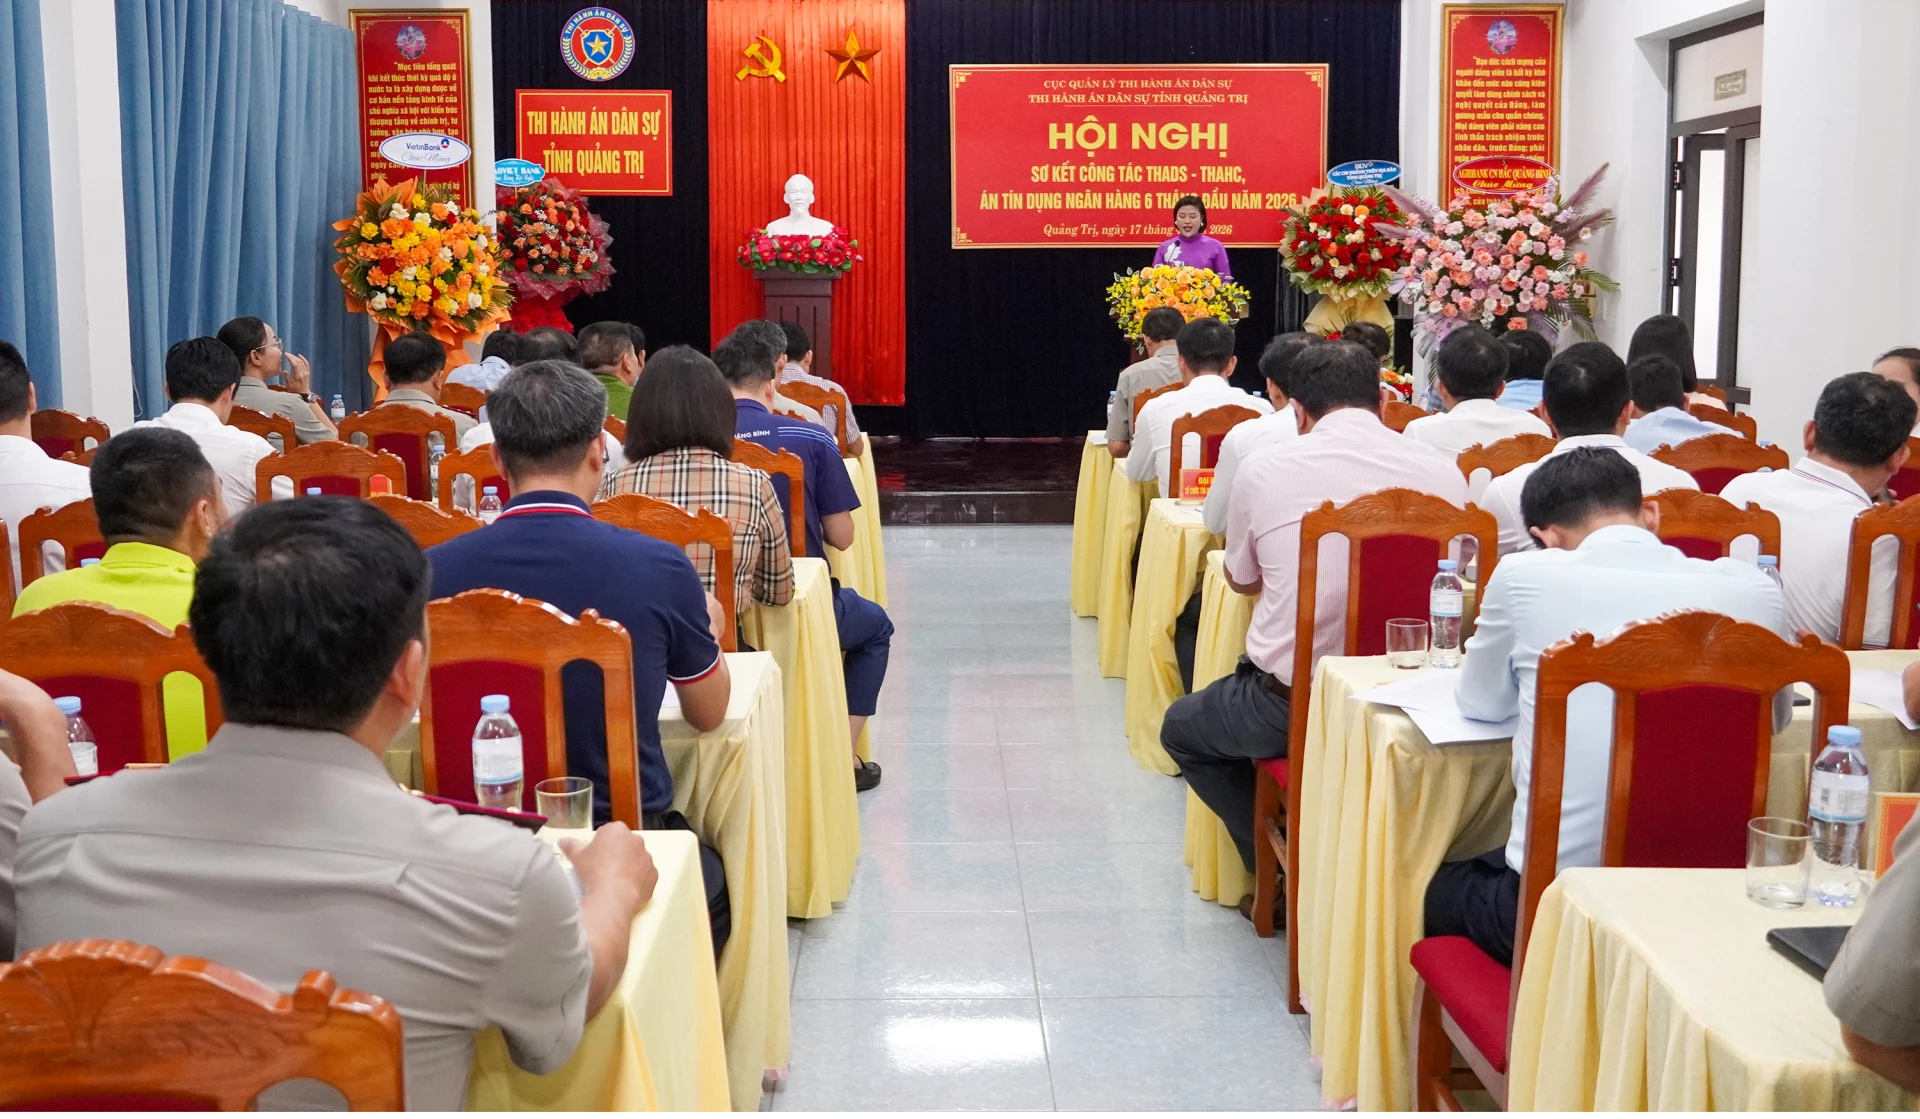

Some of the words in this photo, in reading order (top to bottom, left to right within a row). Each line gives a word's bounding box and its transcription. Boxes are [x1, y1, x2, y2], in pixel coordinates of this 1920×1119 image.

[564, 23, 575, 34] THI
[574, 10, 593, 23] HÀNH
[606, 12, 620, 24] DÂN
[1044, 80, 1067, 90] CỤC
[1068, 78, 1100, 89] QUẢN
[1103, 78, 1118, 88] LÝ
[1119, 80, 1138, 88] THI
[1140, 78, 1172, 88] HÀNH
[1174, 78, 1190, 88] ÁN
[1192, 78, 1215, 88] DÂN
[1217, 79, 1233, 90] SỰ
[1028, 94, 1049, 103] THI
[1052, 93, 1085, 103] HÀNH
[1088, 92, 1105, 103] ÁN
[1107, 92, 1132, 103] DÂN
[1134, 93, 1150, 104] SỰ
[1152, 90, 1181, 103] TỈNH
[1184, 90, 1225, 104] QUẢNG
[1228, 94, 1248, 104] TRỊ
[527, 111, 547, 134] THI
[551, 106, 586, 134] HÀNH
[590, 106, 608, 135] ÁN
[612, 107, 638, 135] DÂN
[642, 109, 661, 140] SỰ
[1049, 115, 1116, 157] HỘI
[1132, 123, 1227, 157] NGHỊ
[543, 142, 573, 173] TỈNH
[577, 142, 620, 176] QUẢNG
[624, 150, 644, 179] TRỊ
[1031, 164, 1049, 182] SƠ
[1052, 160, 1075, 182] KẾT
[1079, 162, 1115, 182] CÔNG
[1118, 162, 1142, 182] TÁC
[1146, 166, 1188, 182] THADS
[1200, 166, 1246, 184] THAHC,
[980, 190, 998, 209] ÁN
[1002, 190, 1022, 209] TÍN
[1027, 193, 1062, 213] DỤNG
[1066, 189, 1102, 209] NGÂN
[1106, 189, 1141, 209] HÀNG
[1145, 193, 1152, 209] 6
[1156, 189, 1197, 209] THÁ
[1202, 187, 1227, 209] ĐẦU
[1232, 190, 1261, 209] NĂM
[1266, 193, 1297, 209] 2026
[1044, 223, 1078, 237] Quảng
[1081, 224, 1099, 237] Trị,
[1102, 224, 1127, 237] ngày
[1130, 225, 1141, 234] 17
[1144, 224, 1173, 236] tháng
[1209, 225, 1232, 235] 2026
